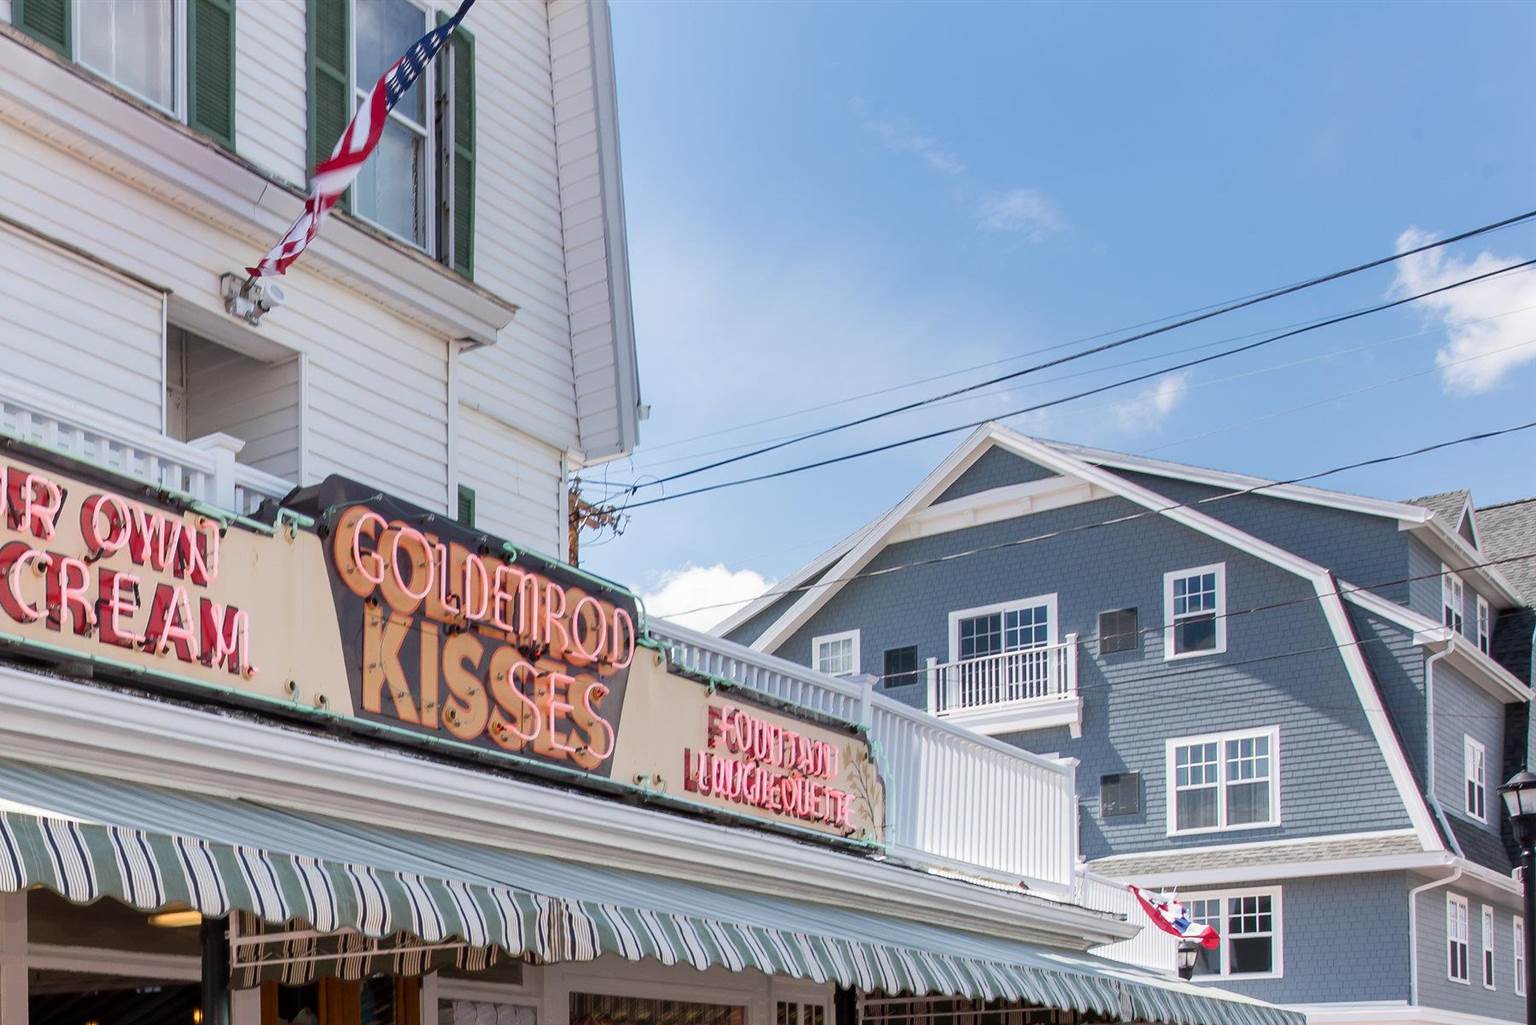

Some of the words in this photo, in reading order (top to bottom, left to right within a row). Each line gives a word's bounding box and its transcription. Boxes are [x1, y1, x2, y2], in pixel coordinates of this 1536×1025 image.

[79, 491, 221, 586] OWN
[332, 504, 636, 677] GOLDENROD
[362, 600, 616, 771] KISSES
[707, 704, 840, 780] FOUNTAIN
